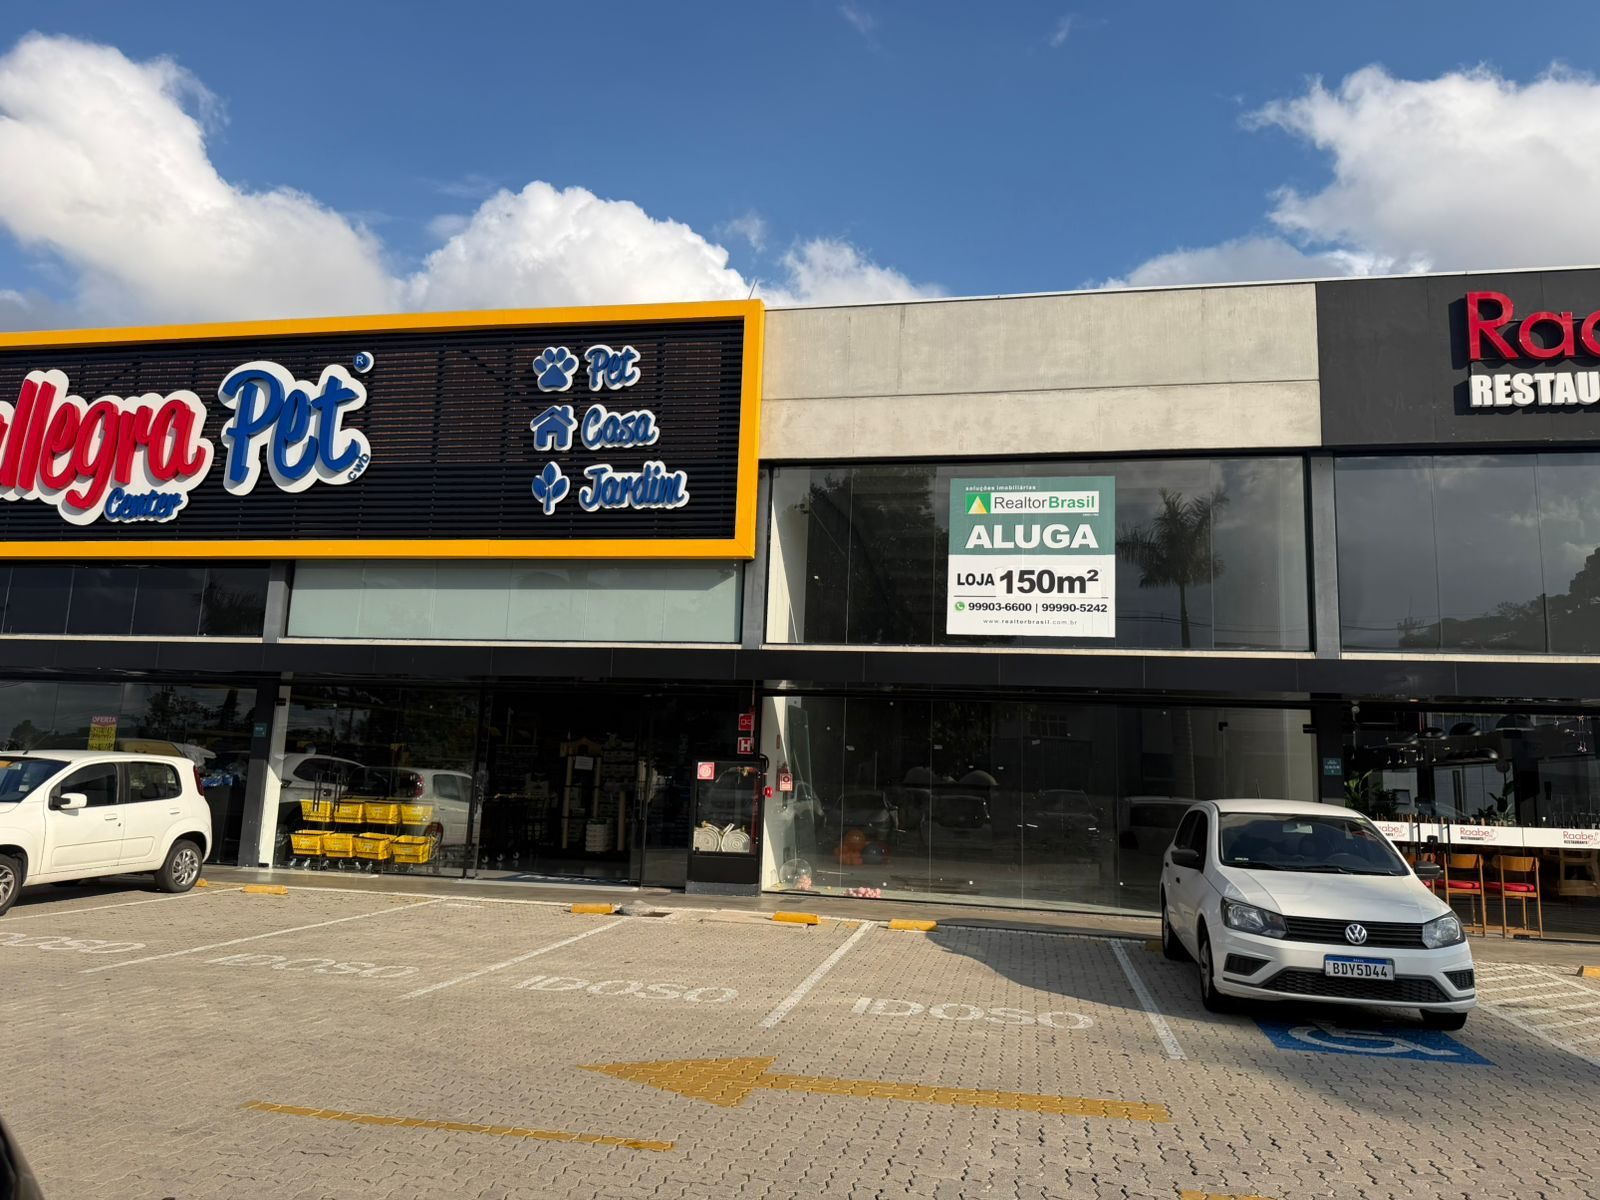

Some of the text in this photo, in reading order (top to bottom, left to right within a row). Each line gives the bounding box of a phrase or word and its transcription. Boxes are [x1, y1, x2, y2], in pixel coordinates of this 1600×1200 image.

[584, 346, 639, 390] Pet
[1469, 371, 1600, 408] RESTAU
[0, 366, 364, 511] llegra Pet
[582, 406, 659, 447] Casa
[580, 462, 687, 509] Jardim
[105, 486, 184, 521] Center
[965, 523, 1099, 550] ALUGA
[957, 573, 995, 586] LOJA
[968, 602, 1108, 613] 99903-6600 99990-5242
[1460, 827, 1489, 837] Raabe
[1563, 831, 1593, 841] Raabe
[1332, 962, 1388, 978] BDY5D44
[510, 975, 739, 1002] IDOSO
[851, 997, 1095, 1030] IDOSO
